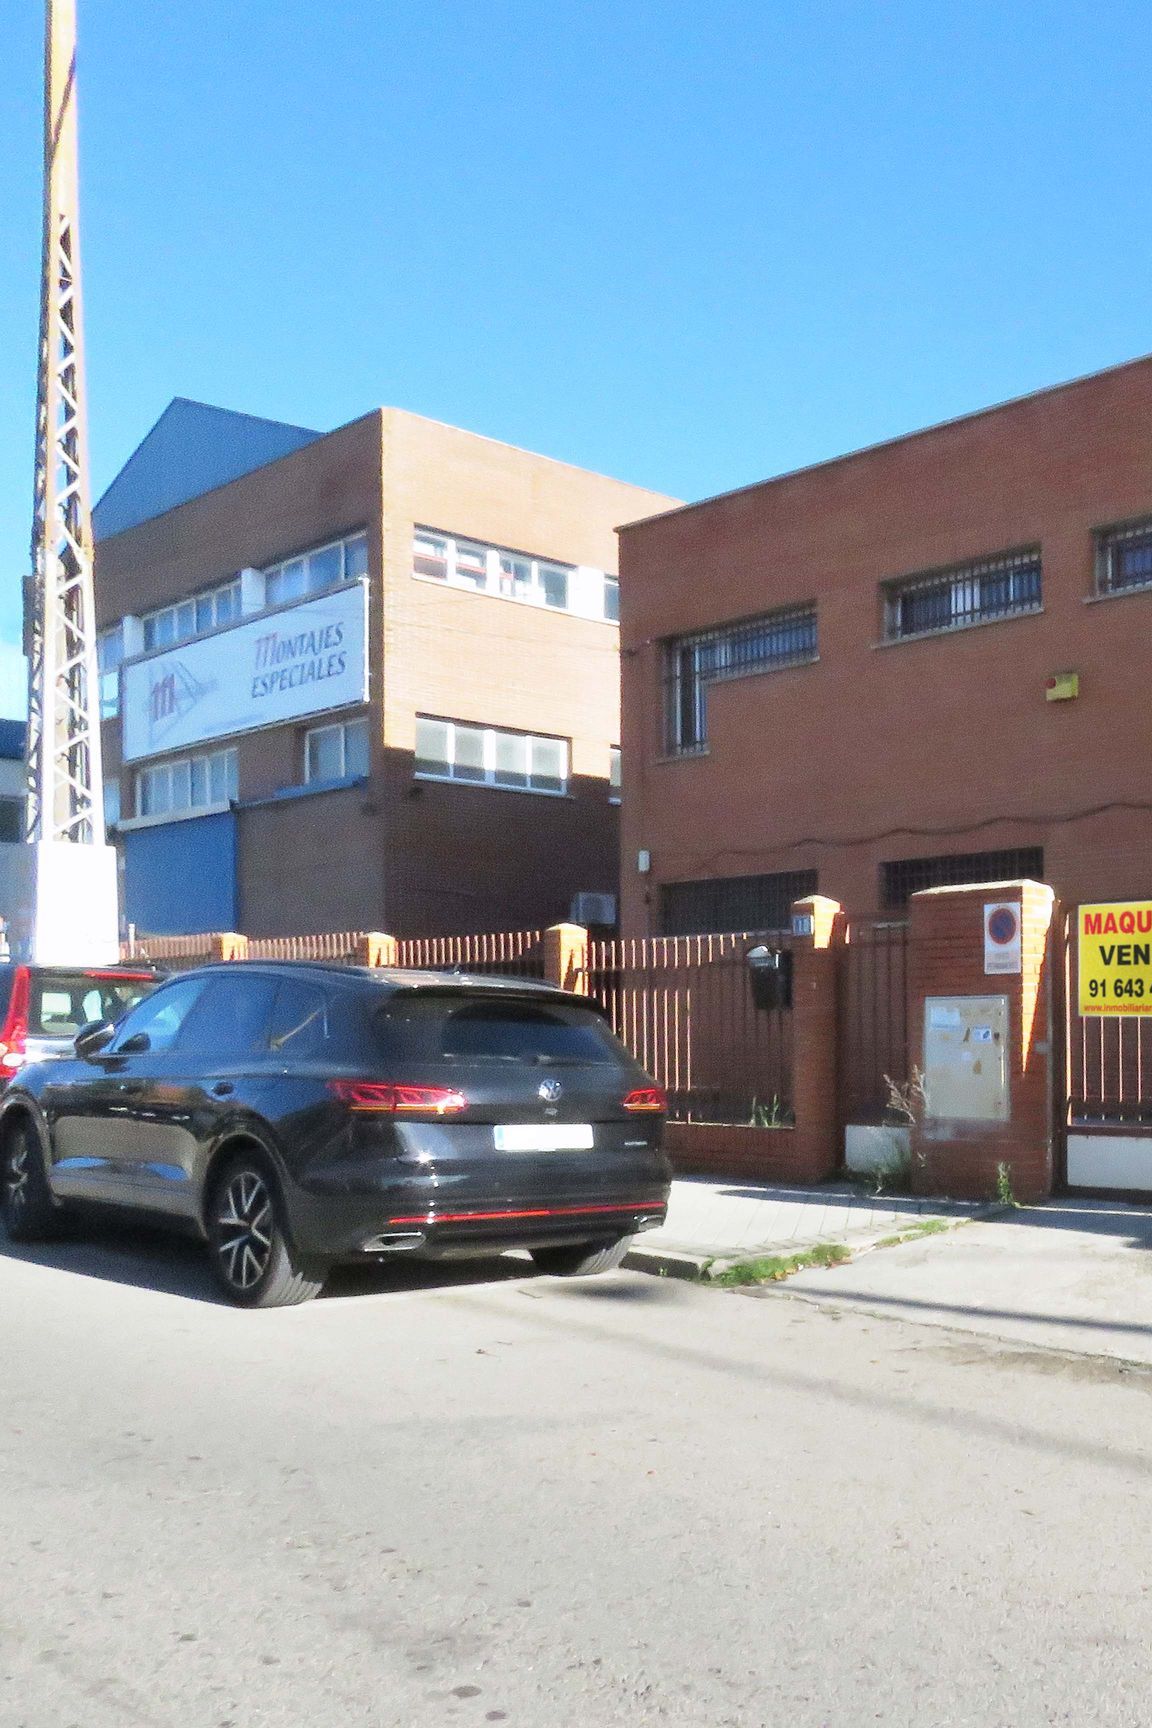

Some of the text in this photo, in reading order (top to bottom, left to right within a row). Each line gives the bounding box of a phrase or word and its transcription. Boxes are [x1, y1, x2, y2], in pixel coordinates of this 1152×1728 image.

[251, 651, 347, 698] ESPECIALES
[1088, 978, 1106, 998] 91
[1113, 978, 1144, 998] 643
